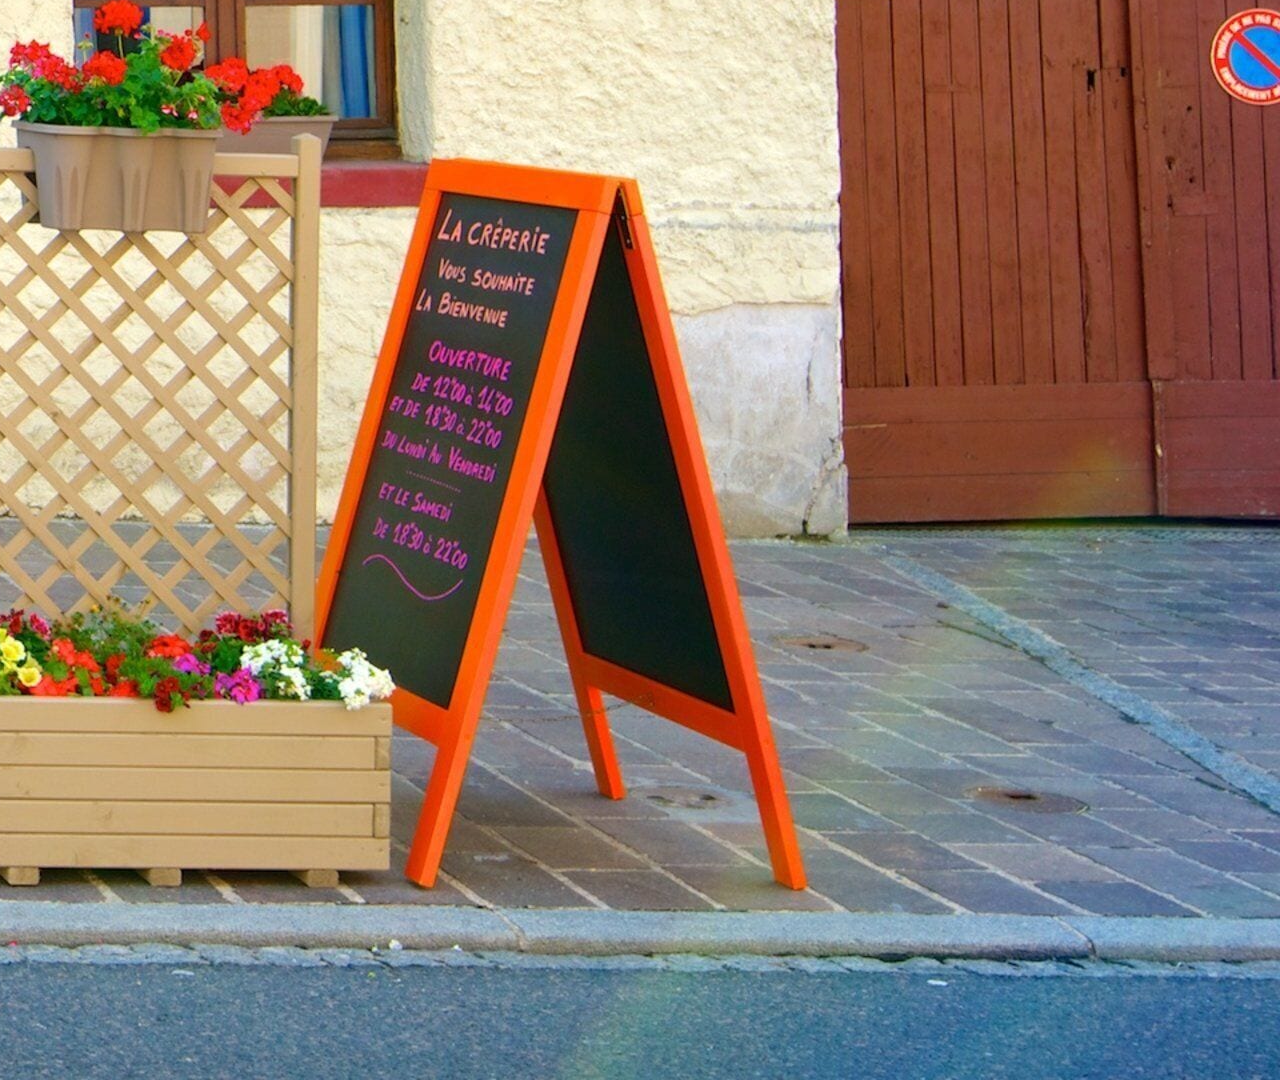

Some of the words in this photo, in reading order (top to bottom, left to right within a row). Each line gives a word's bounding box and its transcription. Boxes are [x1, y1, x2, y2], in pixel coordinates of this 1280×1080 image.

[428, 340, 512, 381] OUVERTURE
[411, 372, 431, 392] DE
[389, 396, 404, 412] ET
[403, 399, 421, 418] DE
[381, 430, 398, 449] DU
[379, 482, 396, 500] ET
[394, 487, 410, 506] LE
[373, 517, 389, 539] DE
